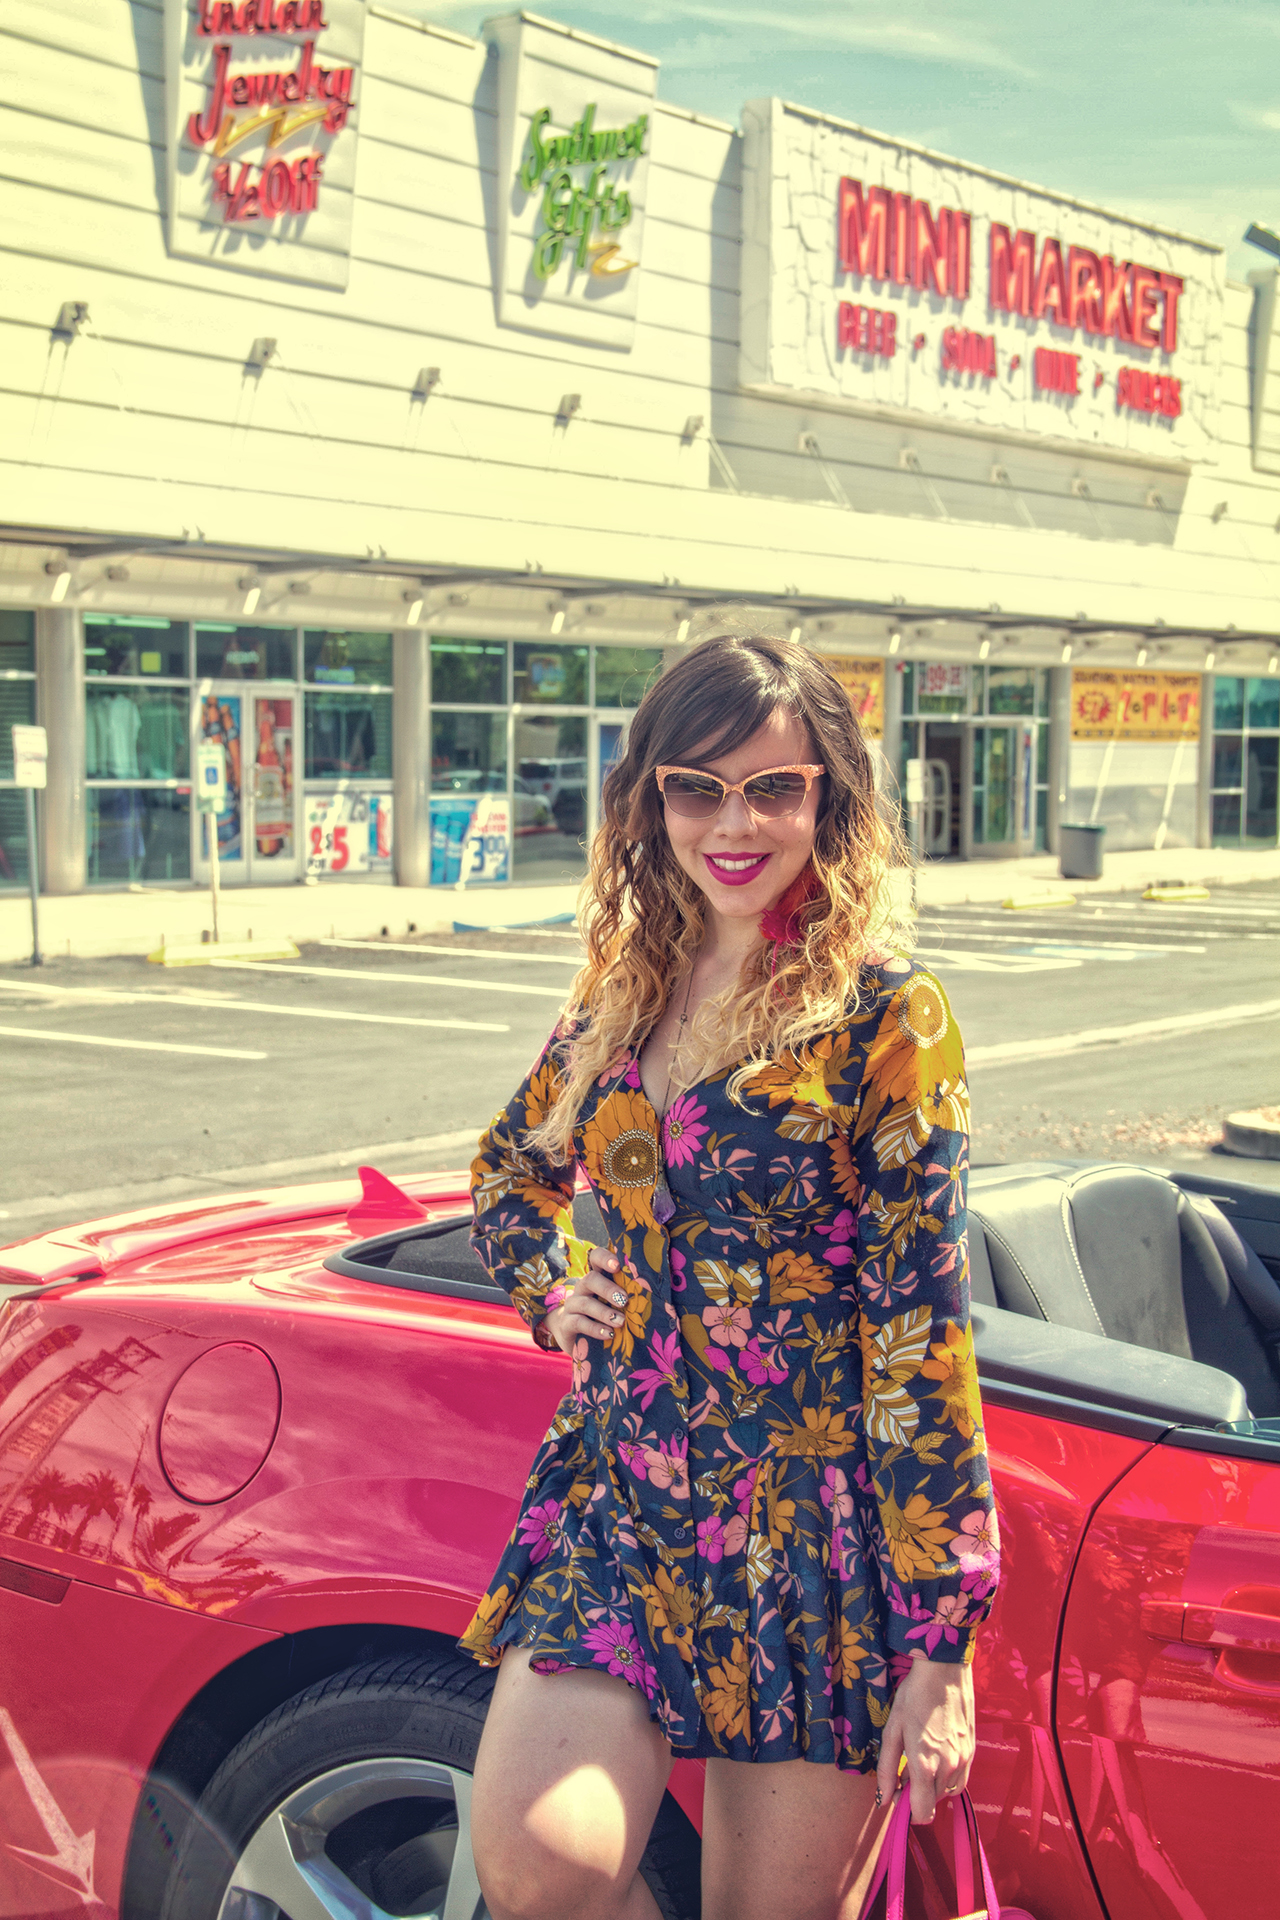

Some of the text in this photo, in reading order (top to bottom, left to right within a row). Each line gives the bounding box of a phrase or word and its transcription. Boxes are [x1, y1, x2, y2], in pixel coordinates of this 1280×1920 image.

[188, 40, 354, 146] Jewelry
[837, 176, 1184, 354] MINI MARKET
[838, 301, 897, 357] BEER
